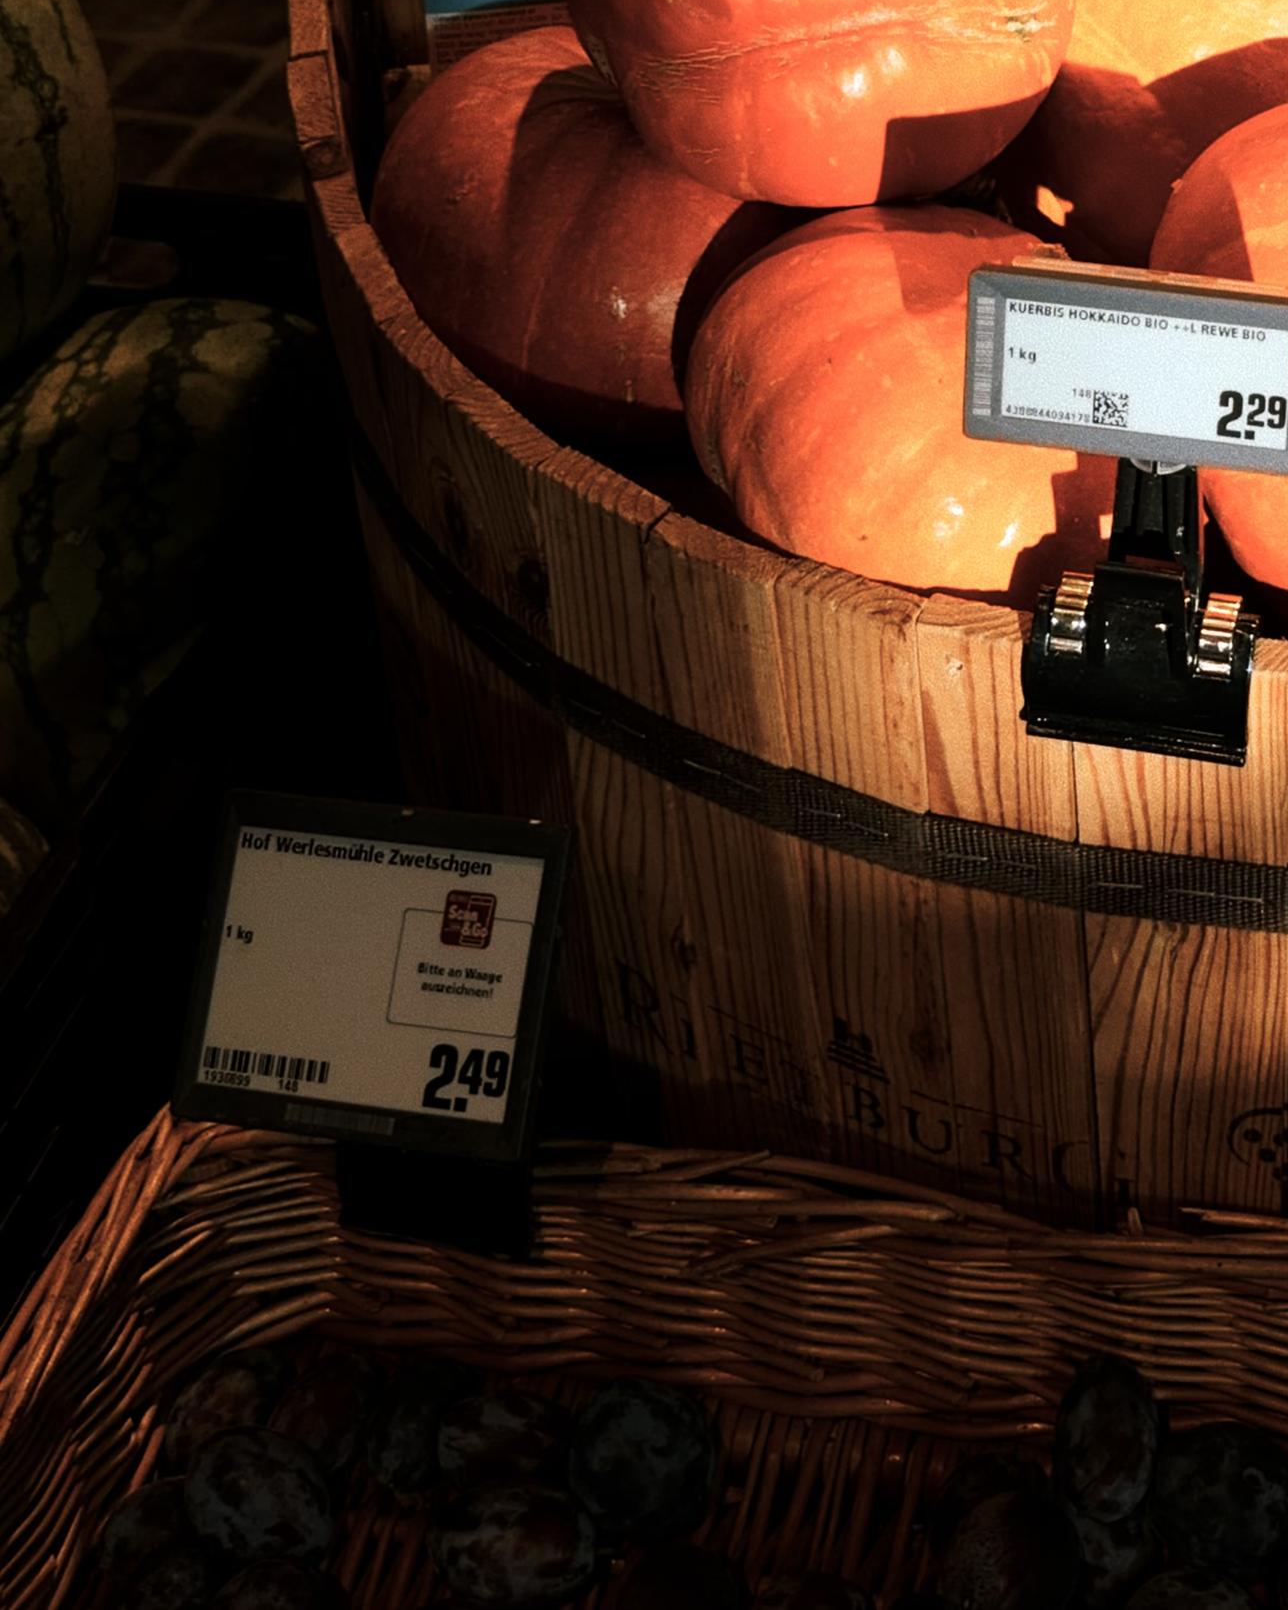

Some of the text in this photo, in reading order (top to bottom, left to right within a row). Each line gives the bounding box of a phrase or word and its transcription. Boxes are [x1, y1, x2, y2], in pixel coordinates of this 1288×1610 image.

[1008, 301, 1065, 318] KUERBIS
[1068, 309, 1141, 327] HOKKAIDO
[1144, 318, 1169, 331] BIO
[1201, 324, 1239, 340] REWE
[1242, 330, 1267, 342] BIO
[1008, 346, 1038, 364] 1 kg
[1216, 390, 1288, 441] 2.29
[241, 832, 493, 878] Hof Werlesmühle Zwetschgen
[226, 925, 254, 945] 1 kg
[417, 962, 503, 985] Bitte an Waage
[278, 1079, 300, 1093] 148
[422, 1043, 510, 1113] 2.49
